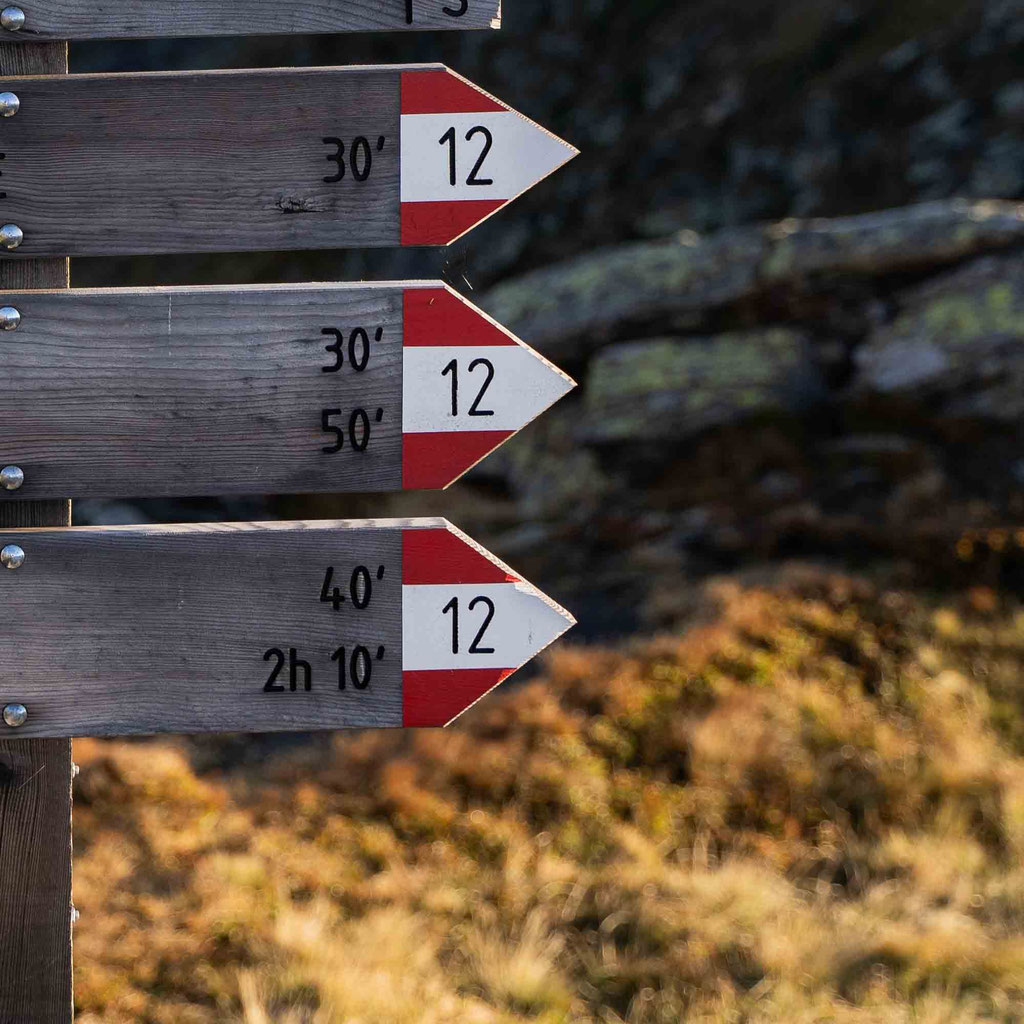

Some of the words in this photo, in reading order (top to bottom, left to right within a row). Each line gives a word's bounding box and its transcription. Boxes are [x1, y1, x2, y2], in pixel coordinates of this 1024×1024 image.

[438, 125, 493, 186] 12
[441, 358, 495, 416] 12
[442, 596, 495, 654] 12
[263, 647, 311, 692] 2h
